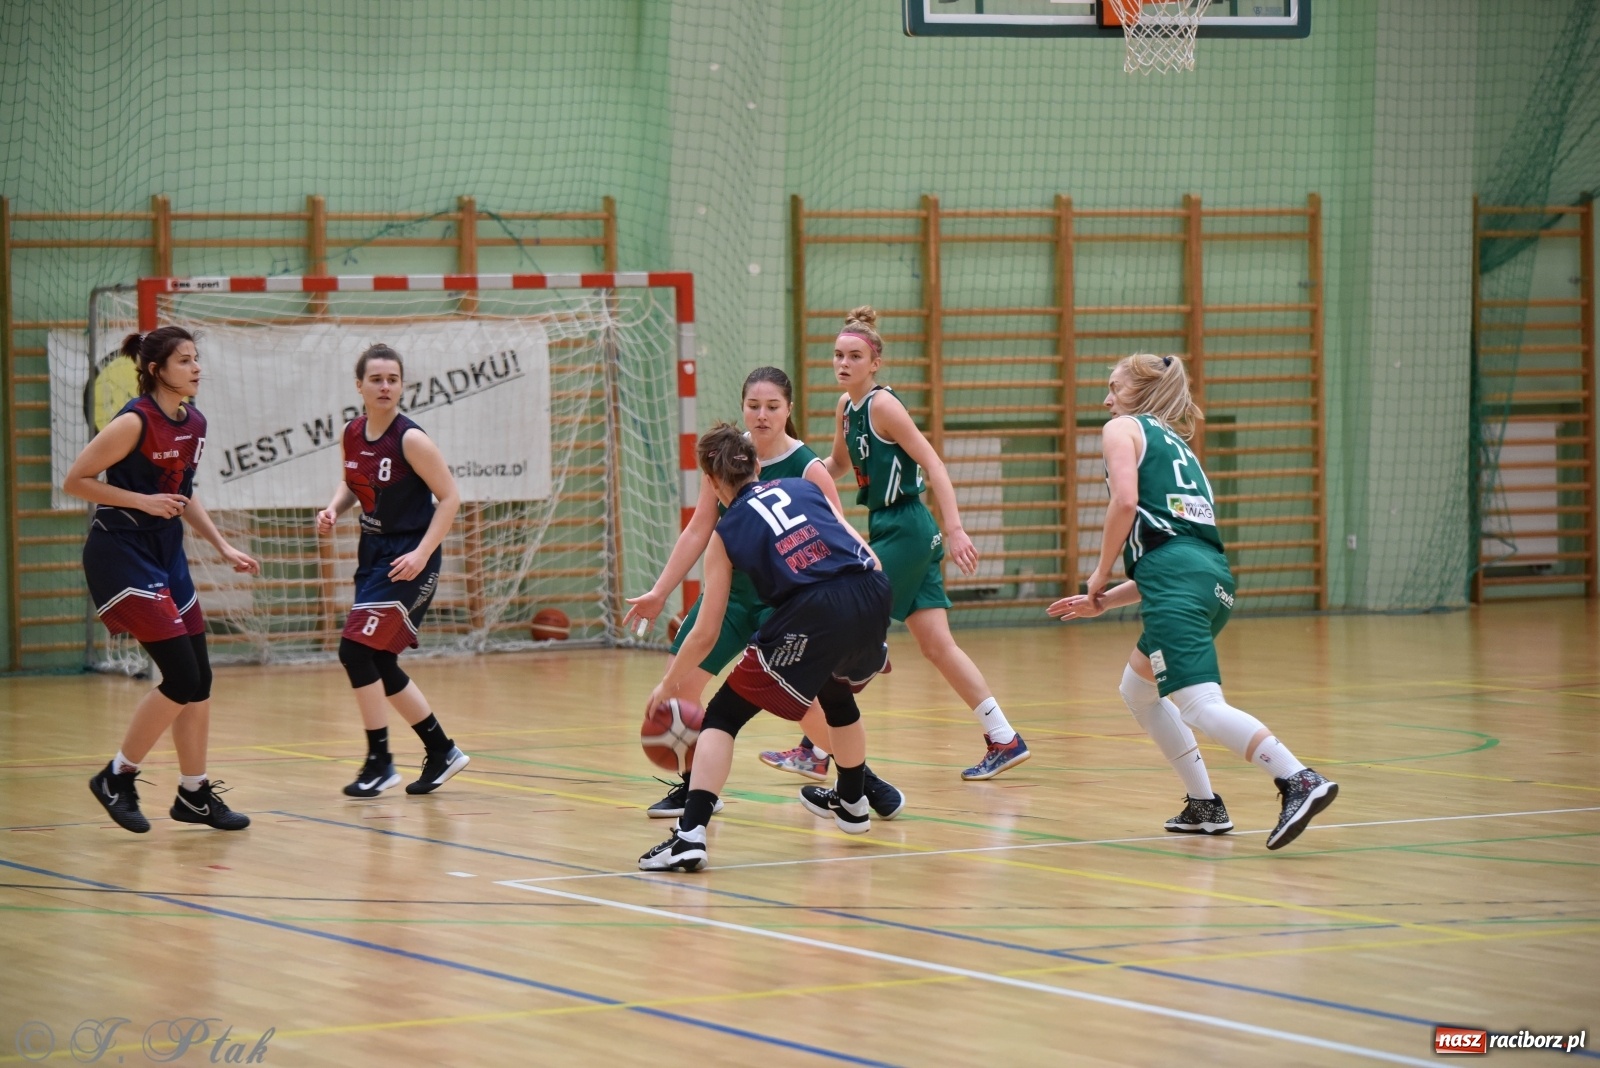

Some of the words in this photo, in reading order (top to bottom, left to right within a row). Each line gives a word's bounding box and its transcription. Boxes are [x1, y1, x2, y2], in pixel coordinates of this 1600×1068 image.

[219, 427, 294, 478] JEST
[302, 413, 335, 446] W
[378, 457, 392, 482] 8
[746, 487, 808, 537] 12
[774, 524, 820, 556] KAMIENICA
[785, 539, 832, 574] POLSKA
[362, 615, 380, 637] 8
